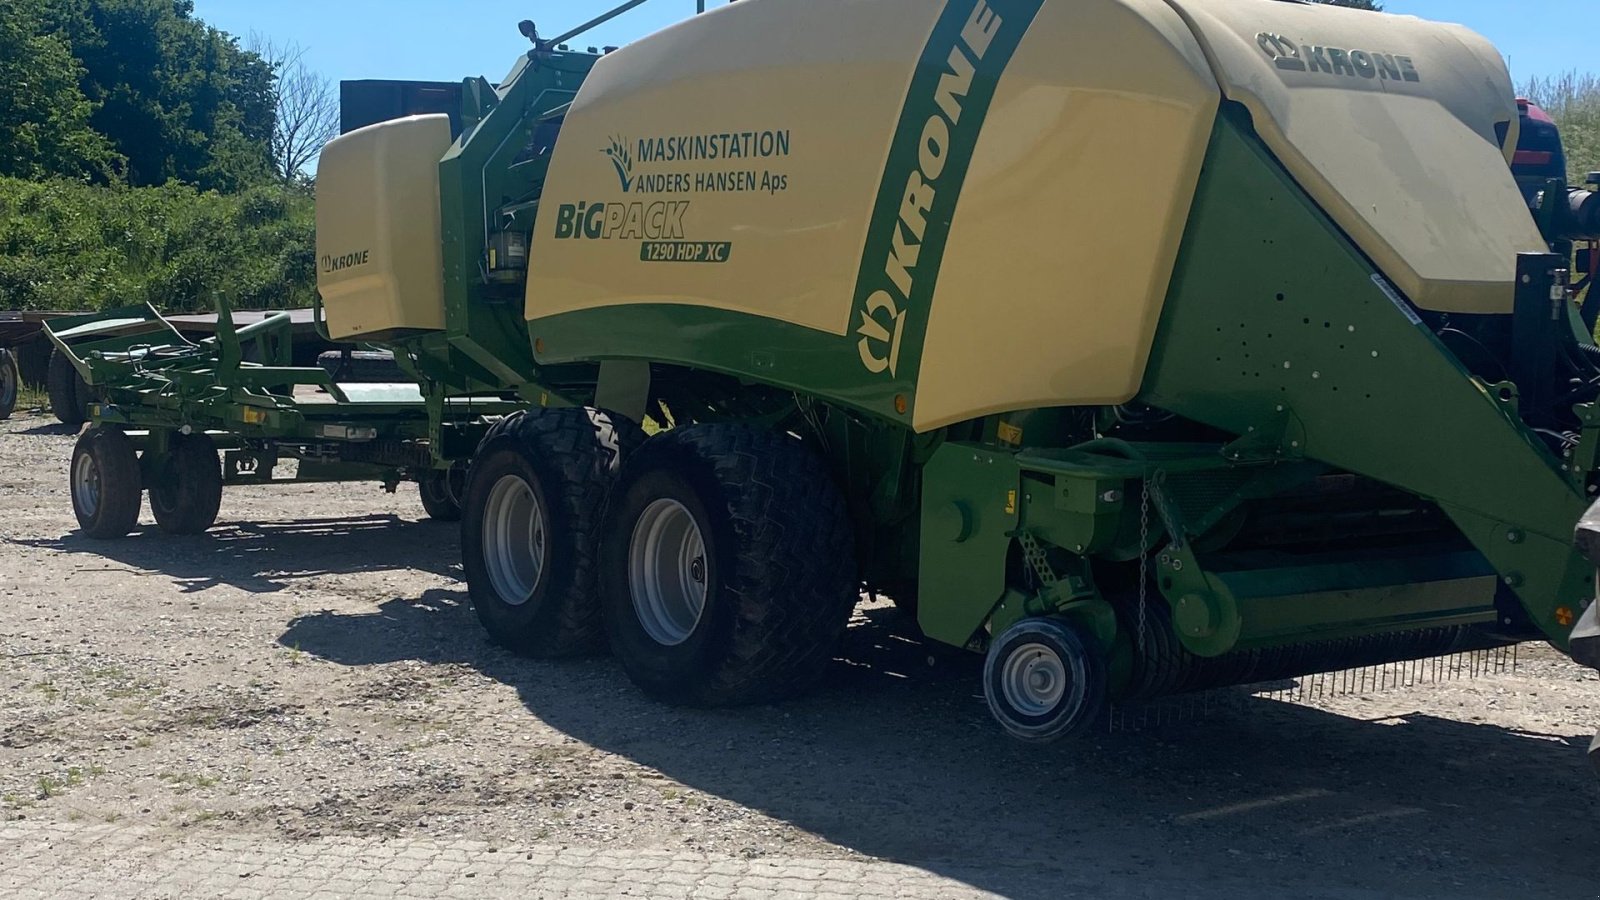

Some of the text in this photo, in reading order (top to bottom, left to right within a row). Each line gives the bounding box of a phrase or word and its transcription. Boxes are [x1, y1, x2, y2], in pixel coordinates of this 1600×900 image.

[1301, 45, 1420, 82] KRONE
[637, 129, 790, 162] MASKINSTATION
[885, 0, 1003, 299] KRONE
[635, 170, 788, 195] ANDERS HANSEN Aps
[331, 249, 369, 272] KRONE
[646, 243, 725, 261] 1290 HDP XC
